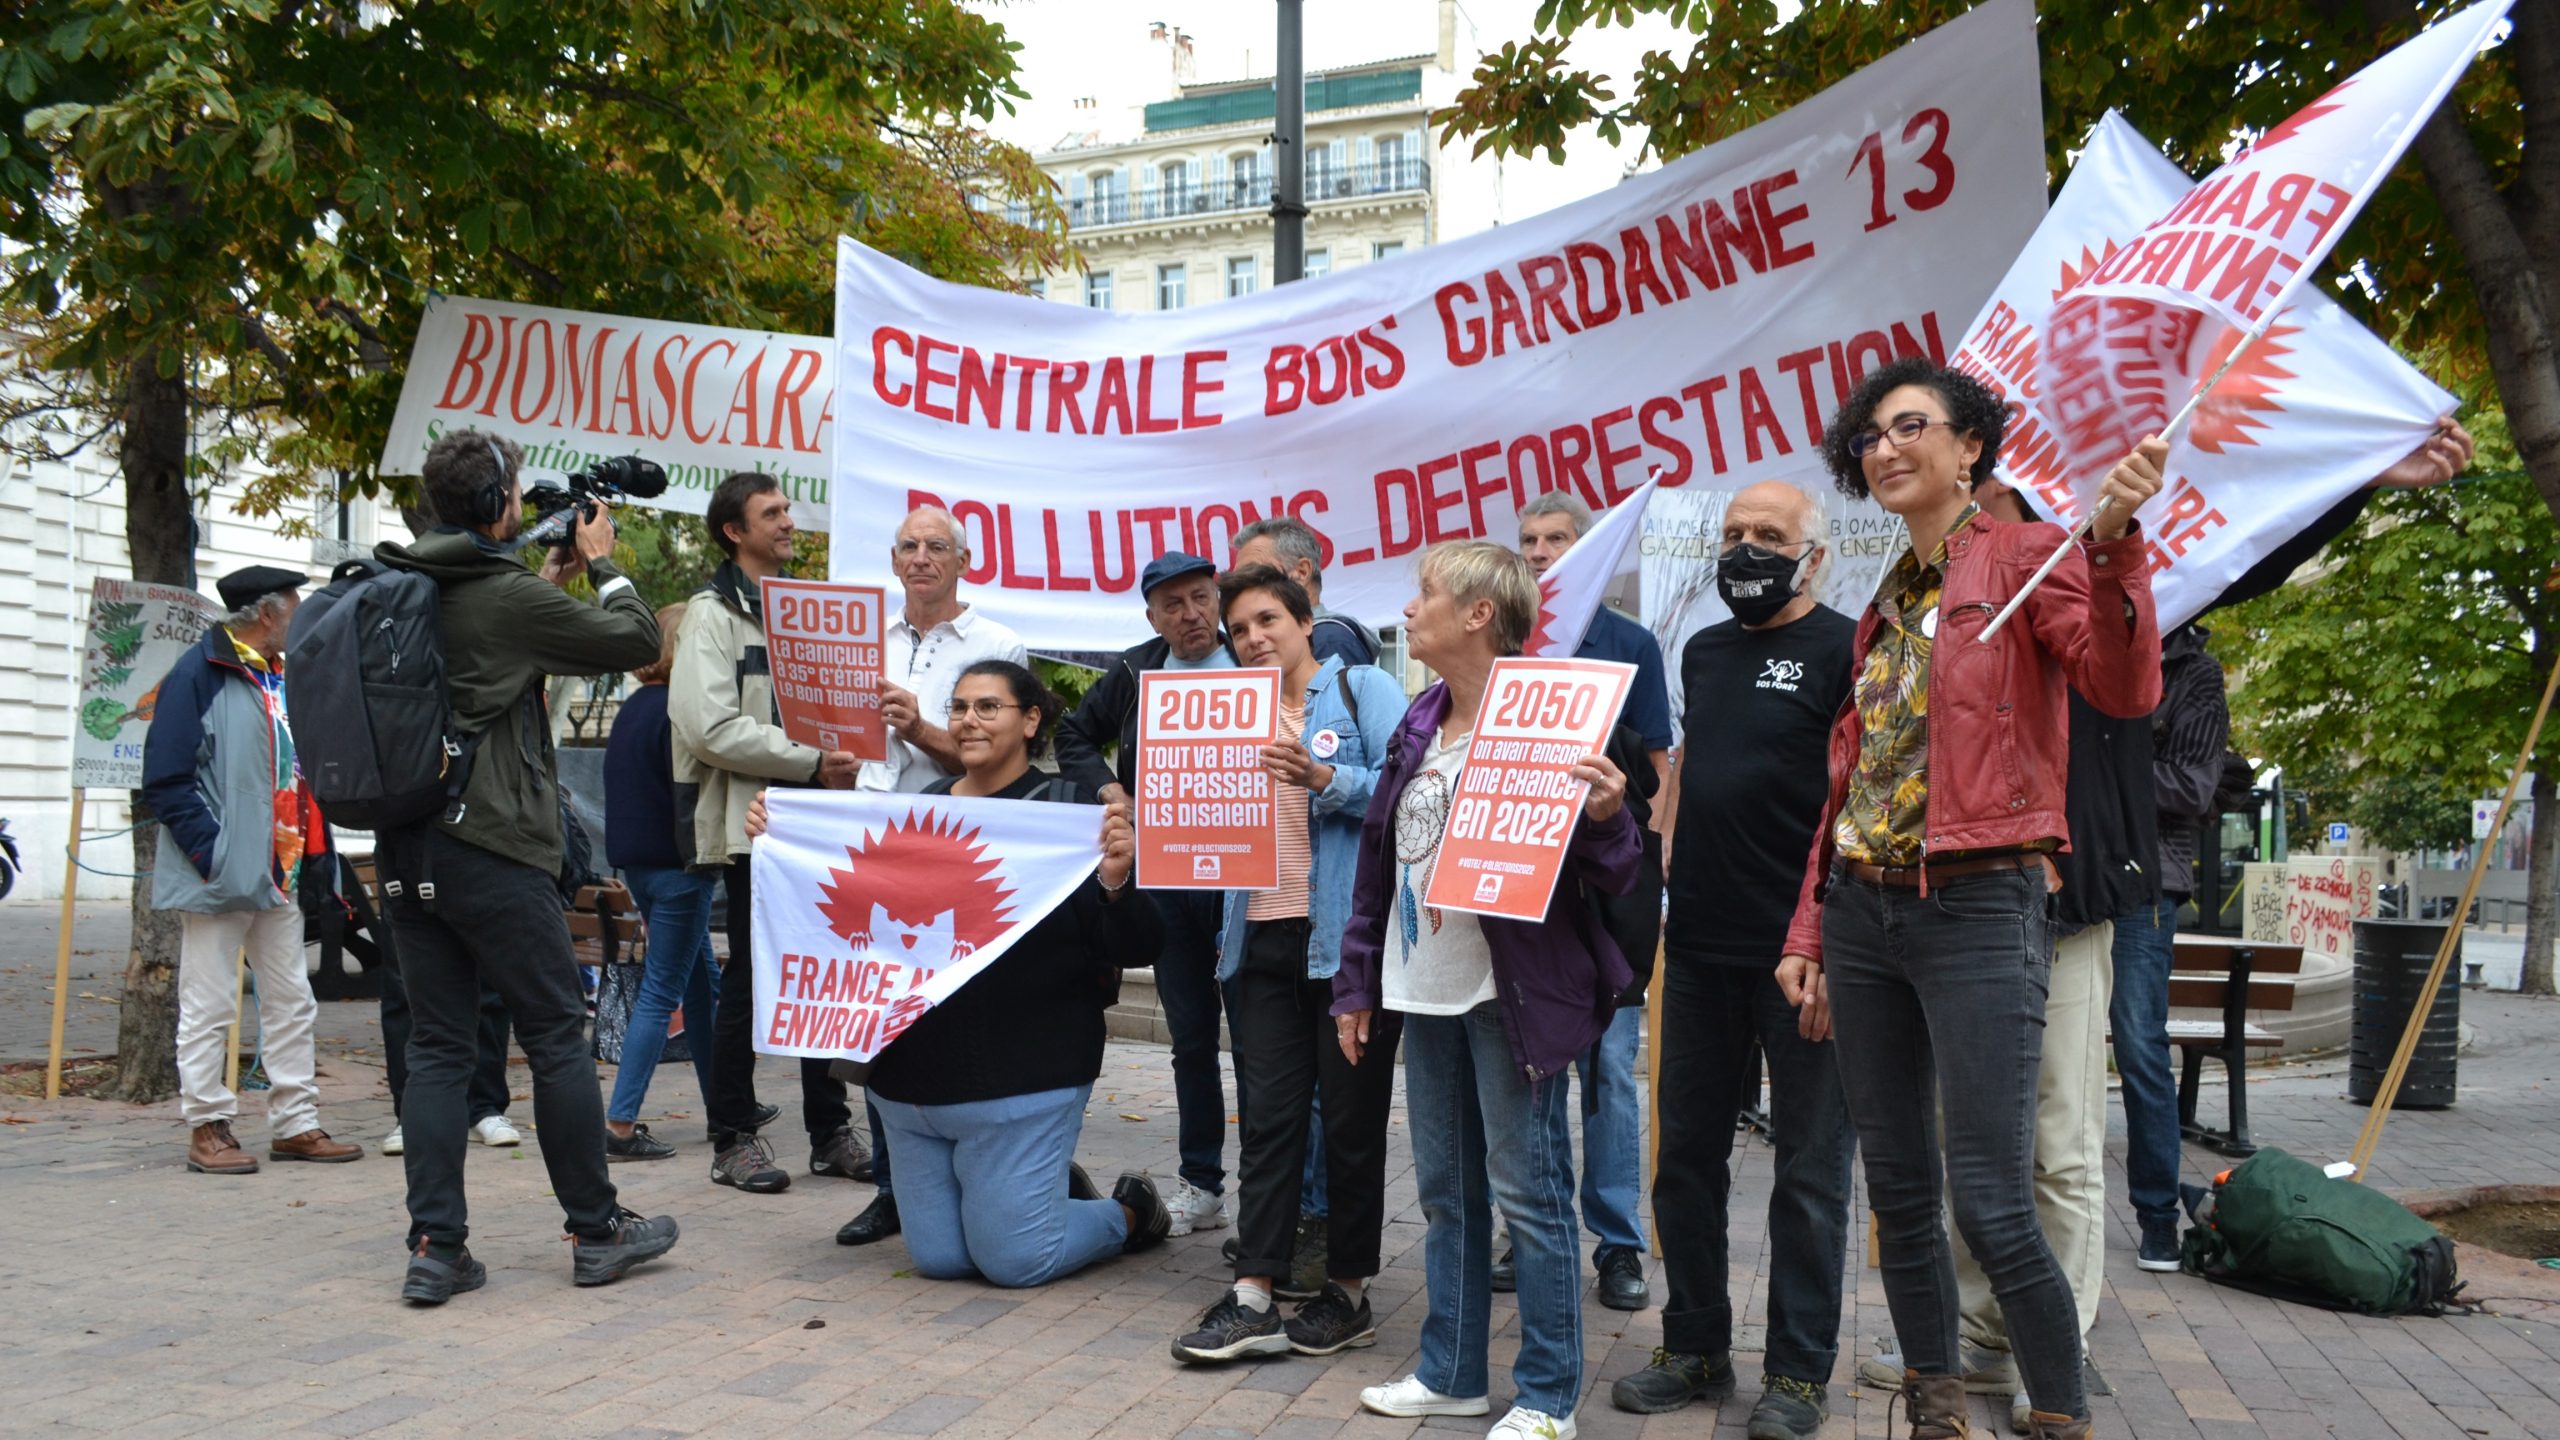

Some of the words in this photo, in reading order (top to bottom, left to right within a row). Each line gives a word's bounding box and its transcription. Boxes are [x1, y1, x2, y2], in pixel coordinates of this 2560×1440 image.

[871, 326, 1228, 436] CENTRALE
[1263, 314, 1406, 417] BOIS
[1434, 169, 1816, 367] GARDANNE
[1846, 107, 1956, 233] 13
[1375, 311, 1946, 559] DEFORESTATION
[779, 595, 867, 637] 2050
[1493, 678, 1600, 732] 2050
[1755, 679, 1771, 689] SOS
[1158, 686, 1259, 733] 2050
[1490, 800, 1571, 848] 2022
[2333, 827, 2344, 839] P
[779, 953, 902, 1006] FRANCE
